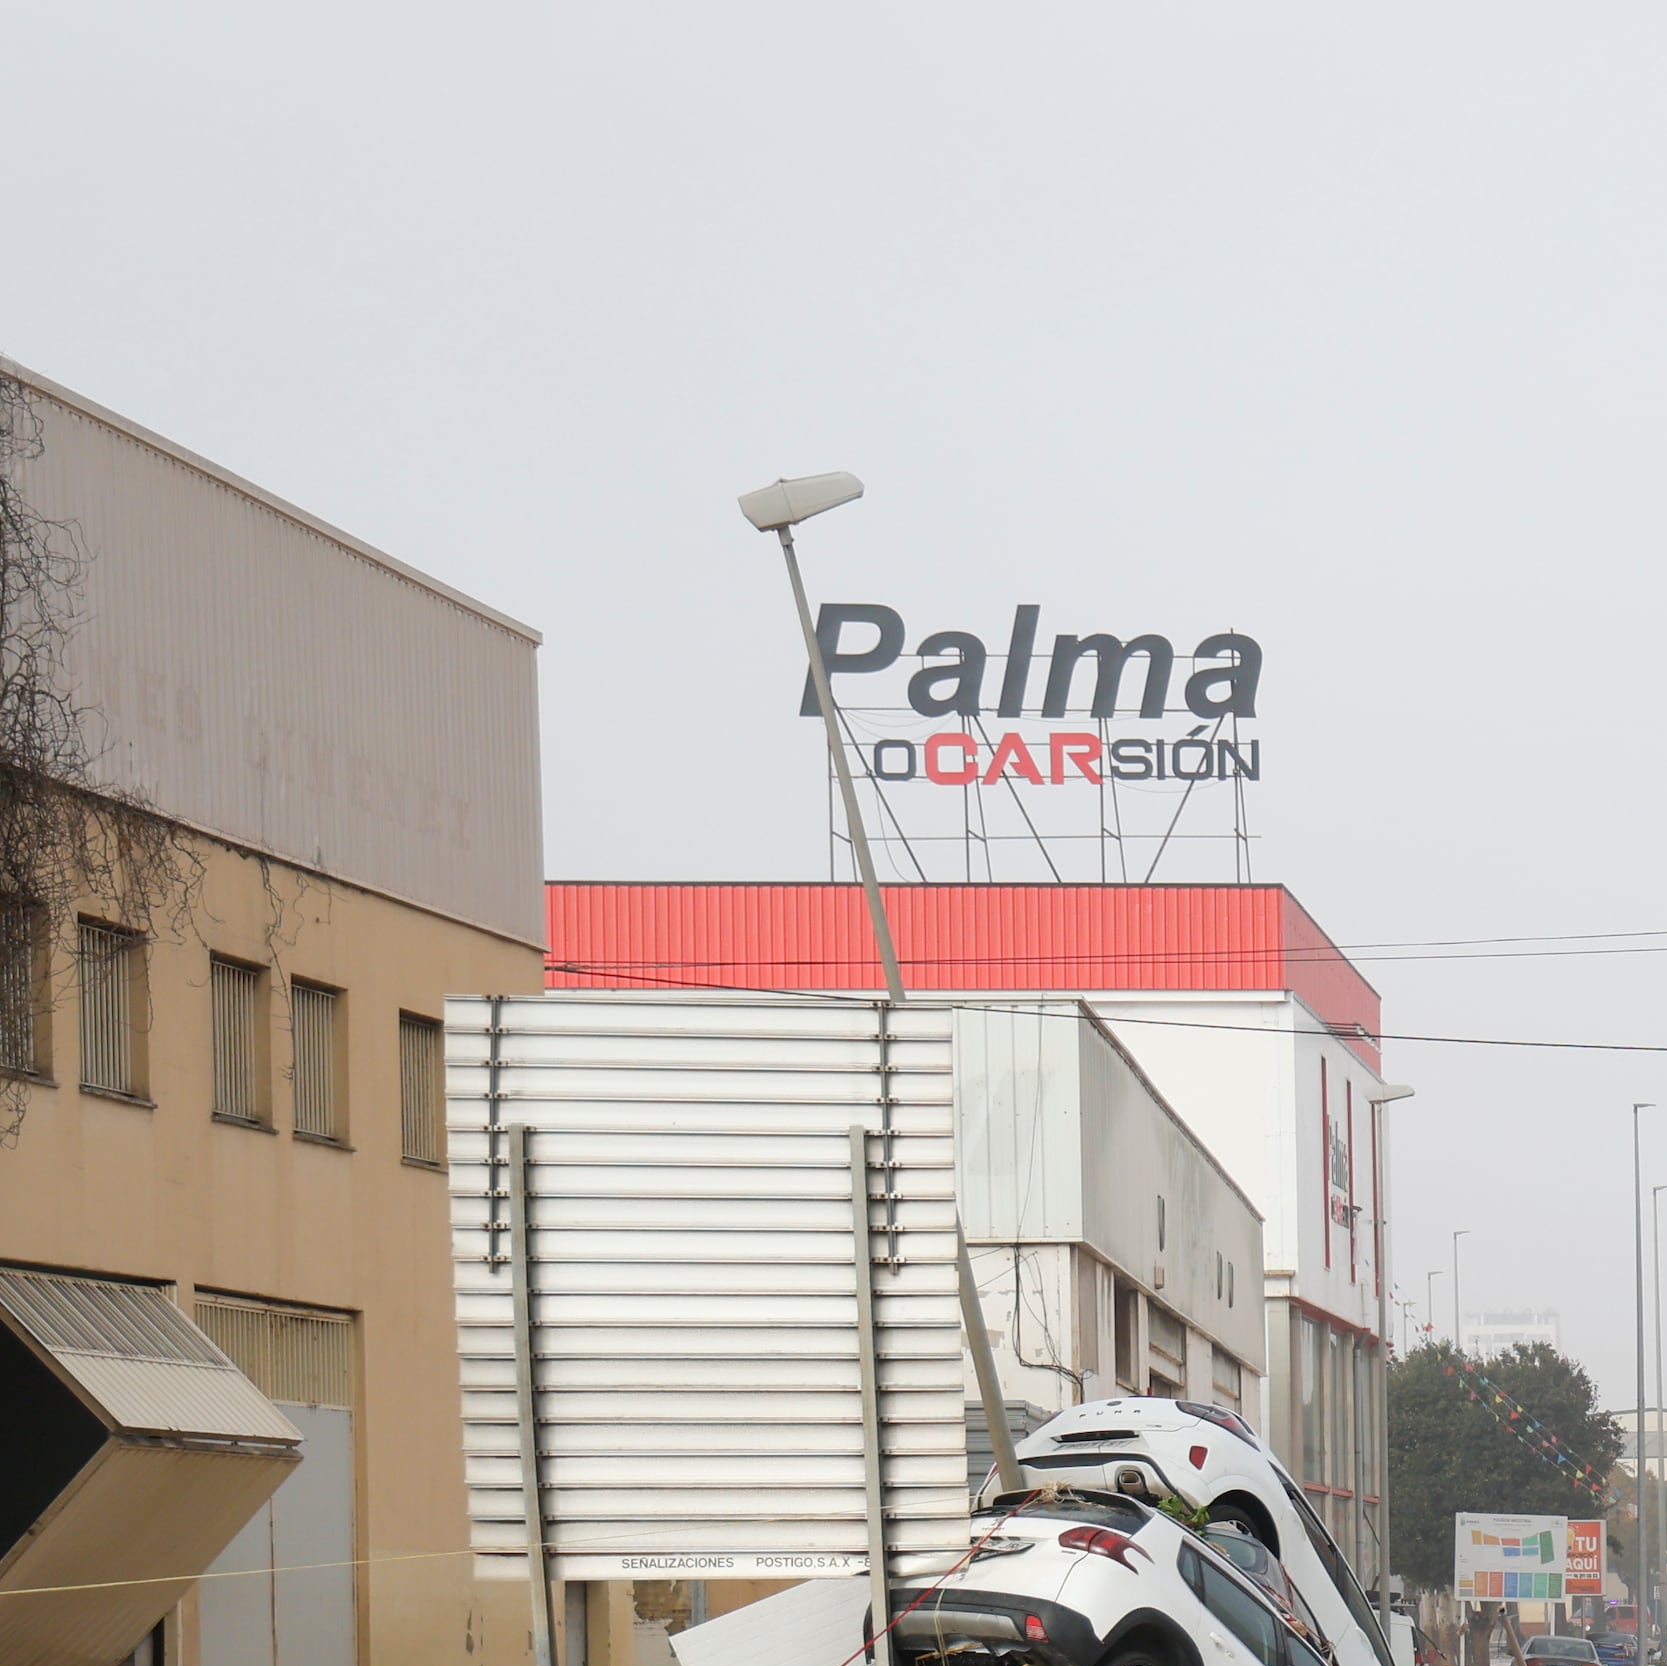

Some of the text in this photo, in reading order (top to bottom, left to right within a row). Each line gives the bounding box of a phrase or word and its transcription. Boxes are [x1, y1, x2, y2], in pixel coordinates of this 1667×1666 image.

[799, 603, 1263, 719] Palma
[1575, 1536, 1597, 1552] TU
[622, 1556, 734, 1569] SEÑALIZACIONES
